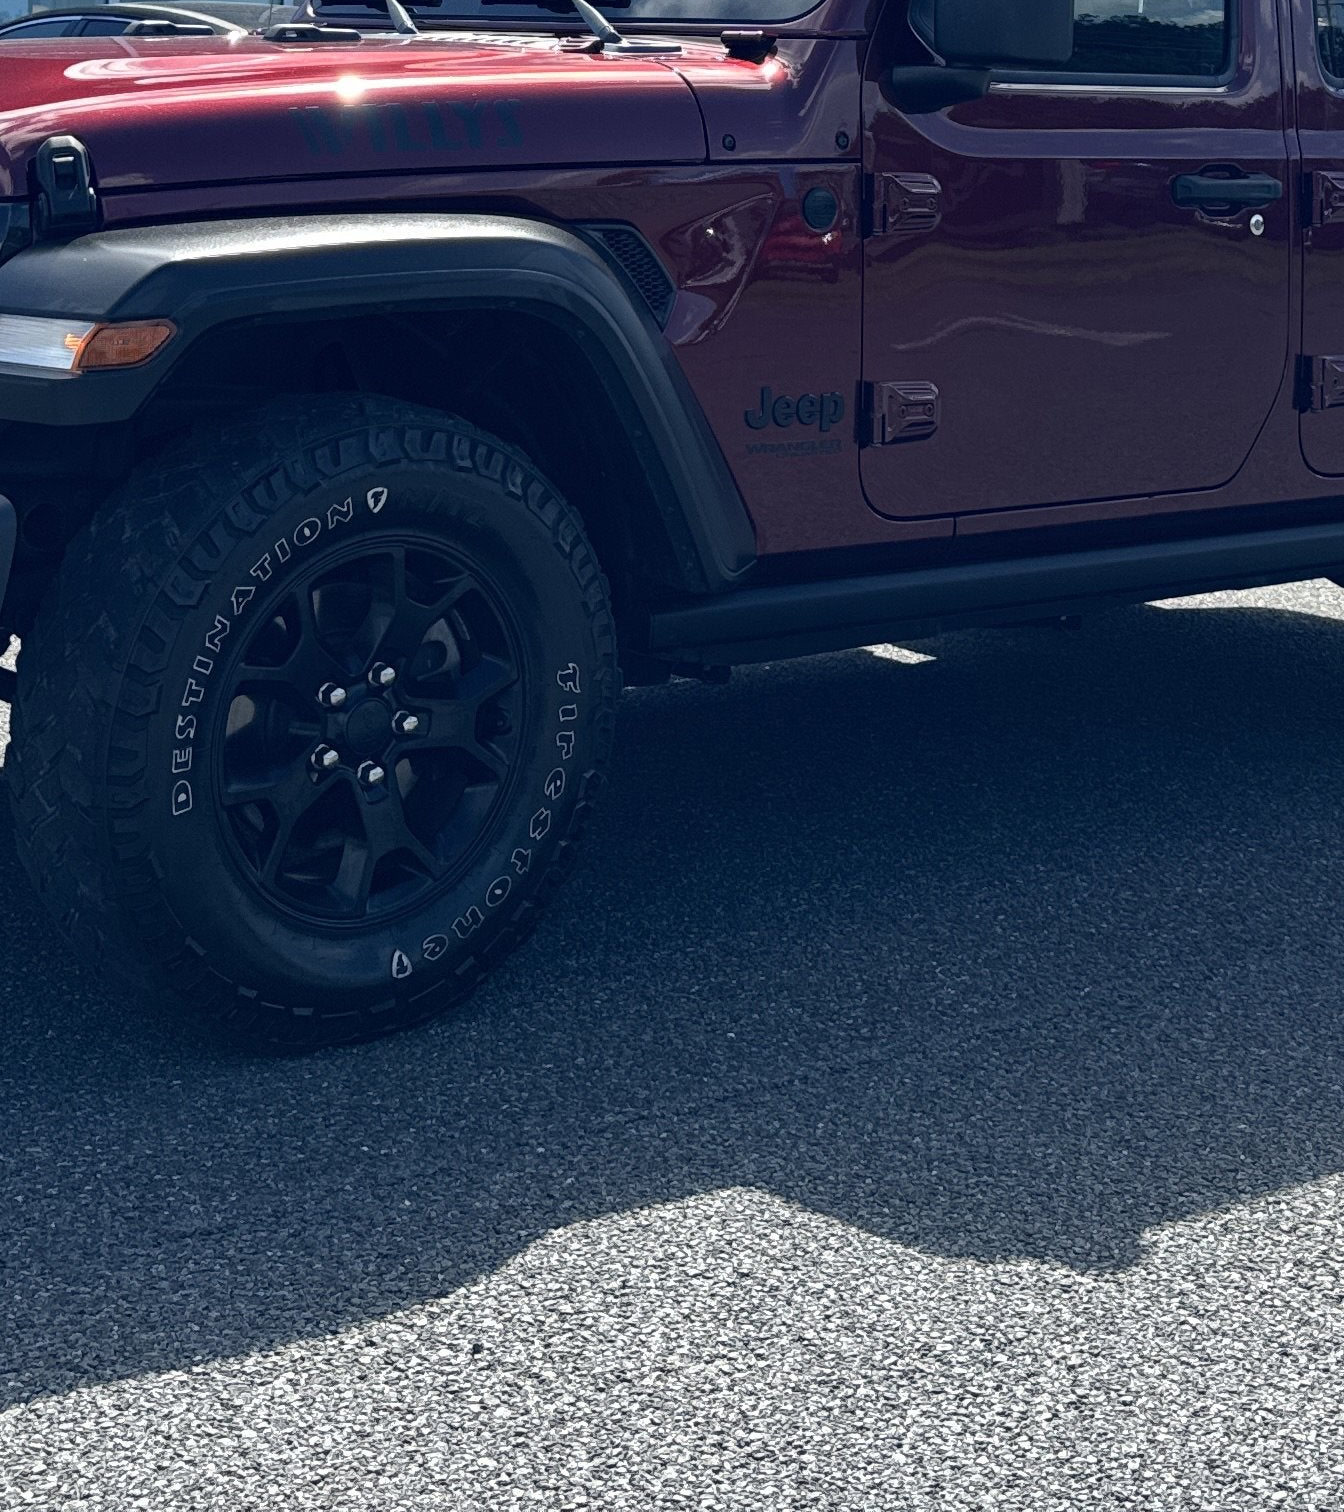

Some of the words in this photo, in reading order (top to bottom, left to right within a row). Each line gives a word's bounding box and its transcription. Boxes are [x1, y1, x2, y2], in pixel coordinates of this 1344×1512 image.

[288, 99, 524, 155] WILLYS
[744, 386, 844, 432] Jeep
[745, 439, 842, 454] WRANGLER
[172, 497, 353, 815] DESTINATION
